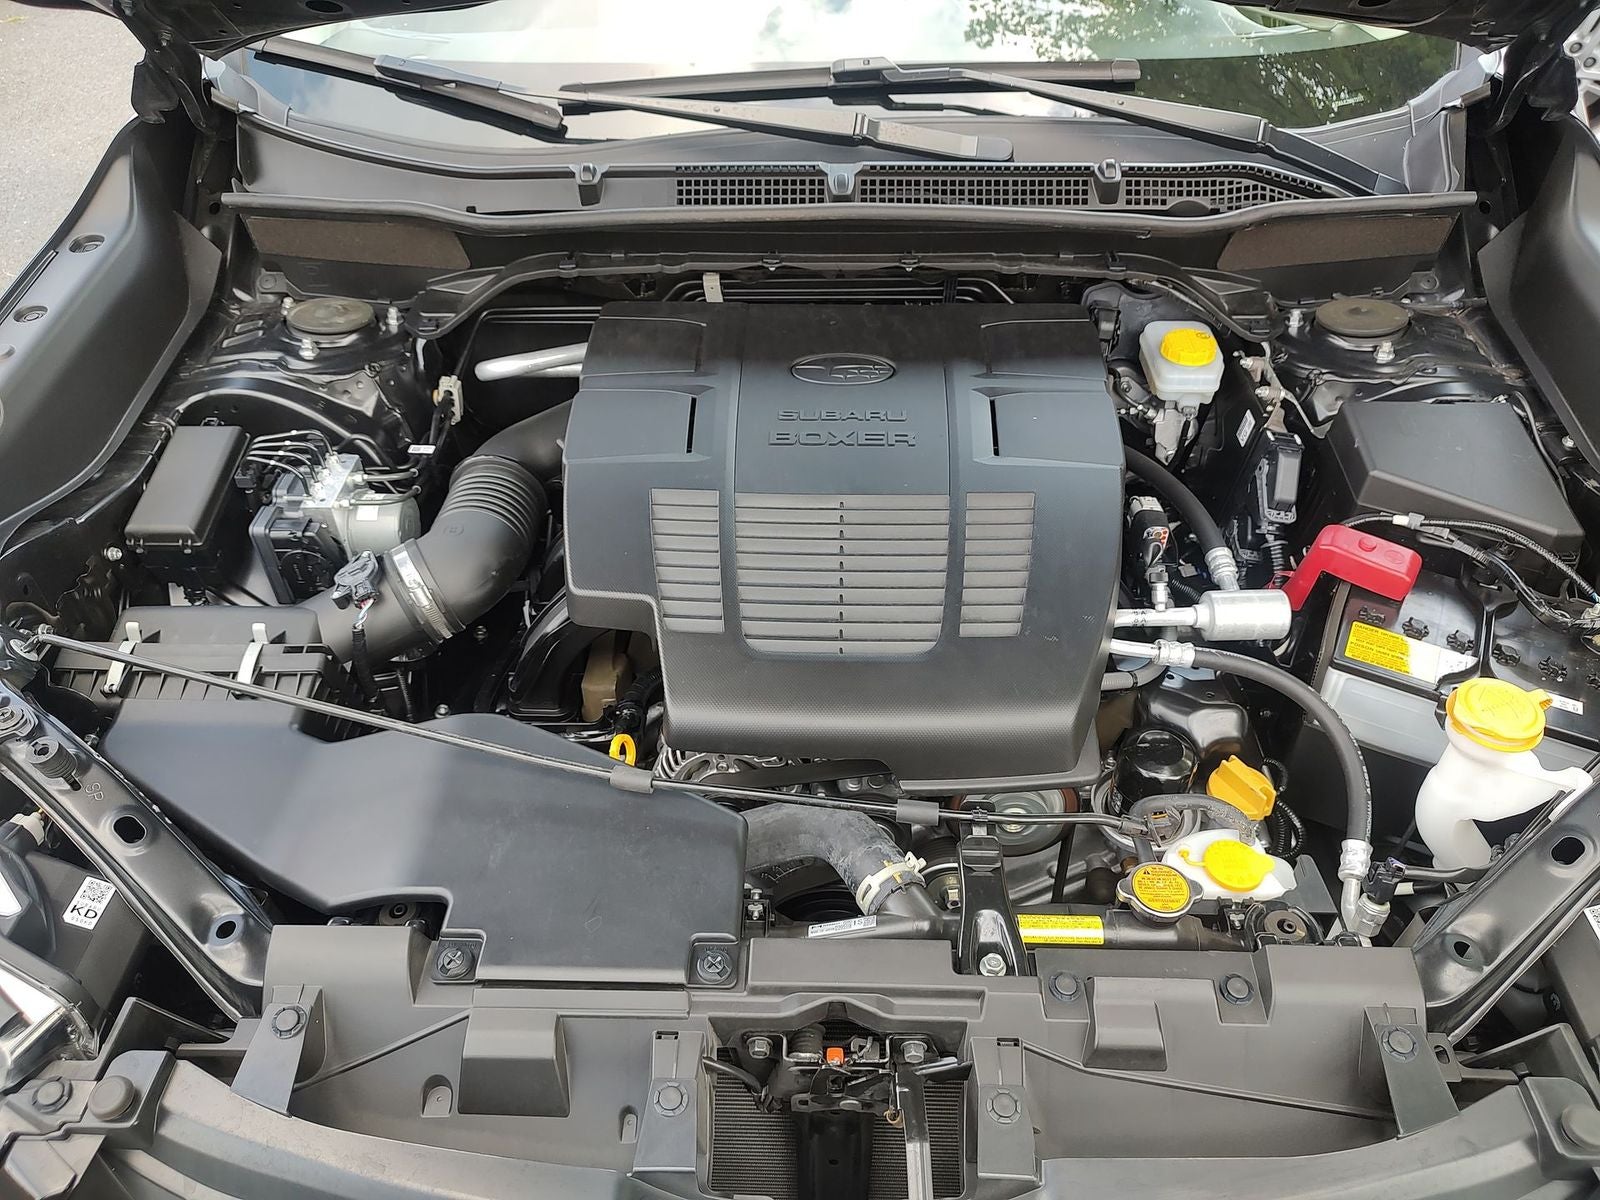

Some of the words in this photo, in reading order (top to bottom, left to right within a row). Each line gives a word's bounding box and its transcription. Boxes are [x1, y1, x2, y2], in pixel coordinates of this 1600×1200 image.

[777, 409, 908, 422] SUBARU
[768, 430, 920, 447] BOXER
[70, 904, 98, 919] KD
